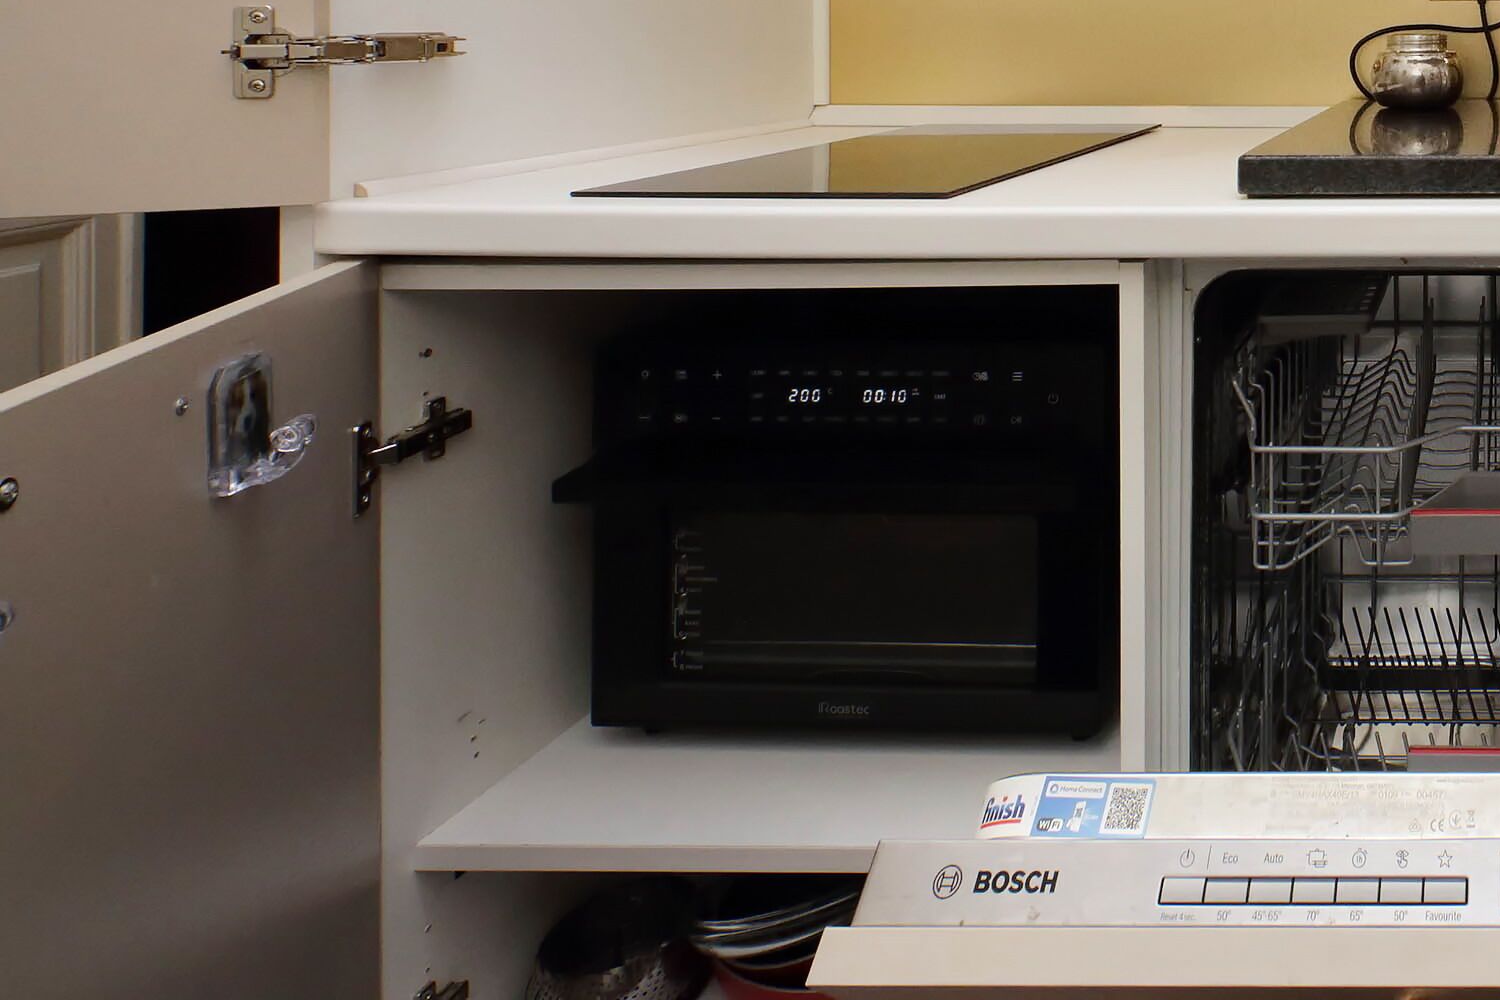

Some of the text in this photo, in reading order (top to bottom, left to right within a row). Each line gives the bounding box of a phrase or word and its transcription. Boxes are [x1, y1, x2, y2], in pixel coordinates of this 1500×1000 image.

[788, 388, 821, 402] 200
[863, 388, 907, 403] 00:10
[982, 795, 1026, 824] finish
[1221, 852, 1239, 864] Eco
[1263, 851, 1284, 864] Auto
[973, 870, 1059, 893] BOSCH
[1306, 910, 1320, 921] 70°
[1349, 910, 1364, 921] 65°
[1425, 911, 1462, 921] Favourite
